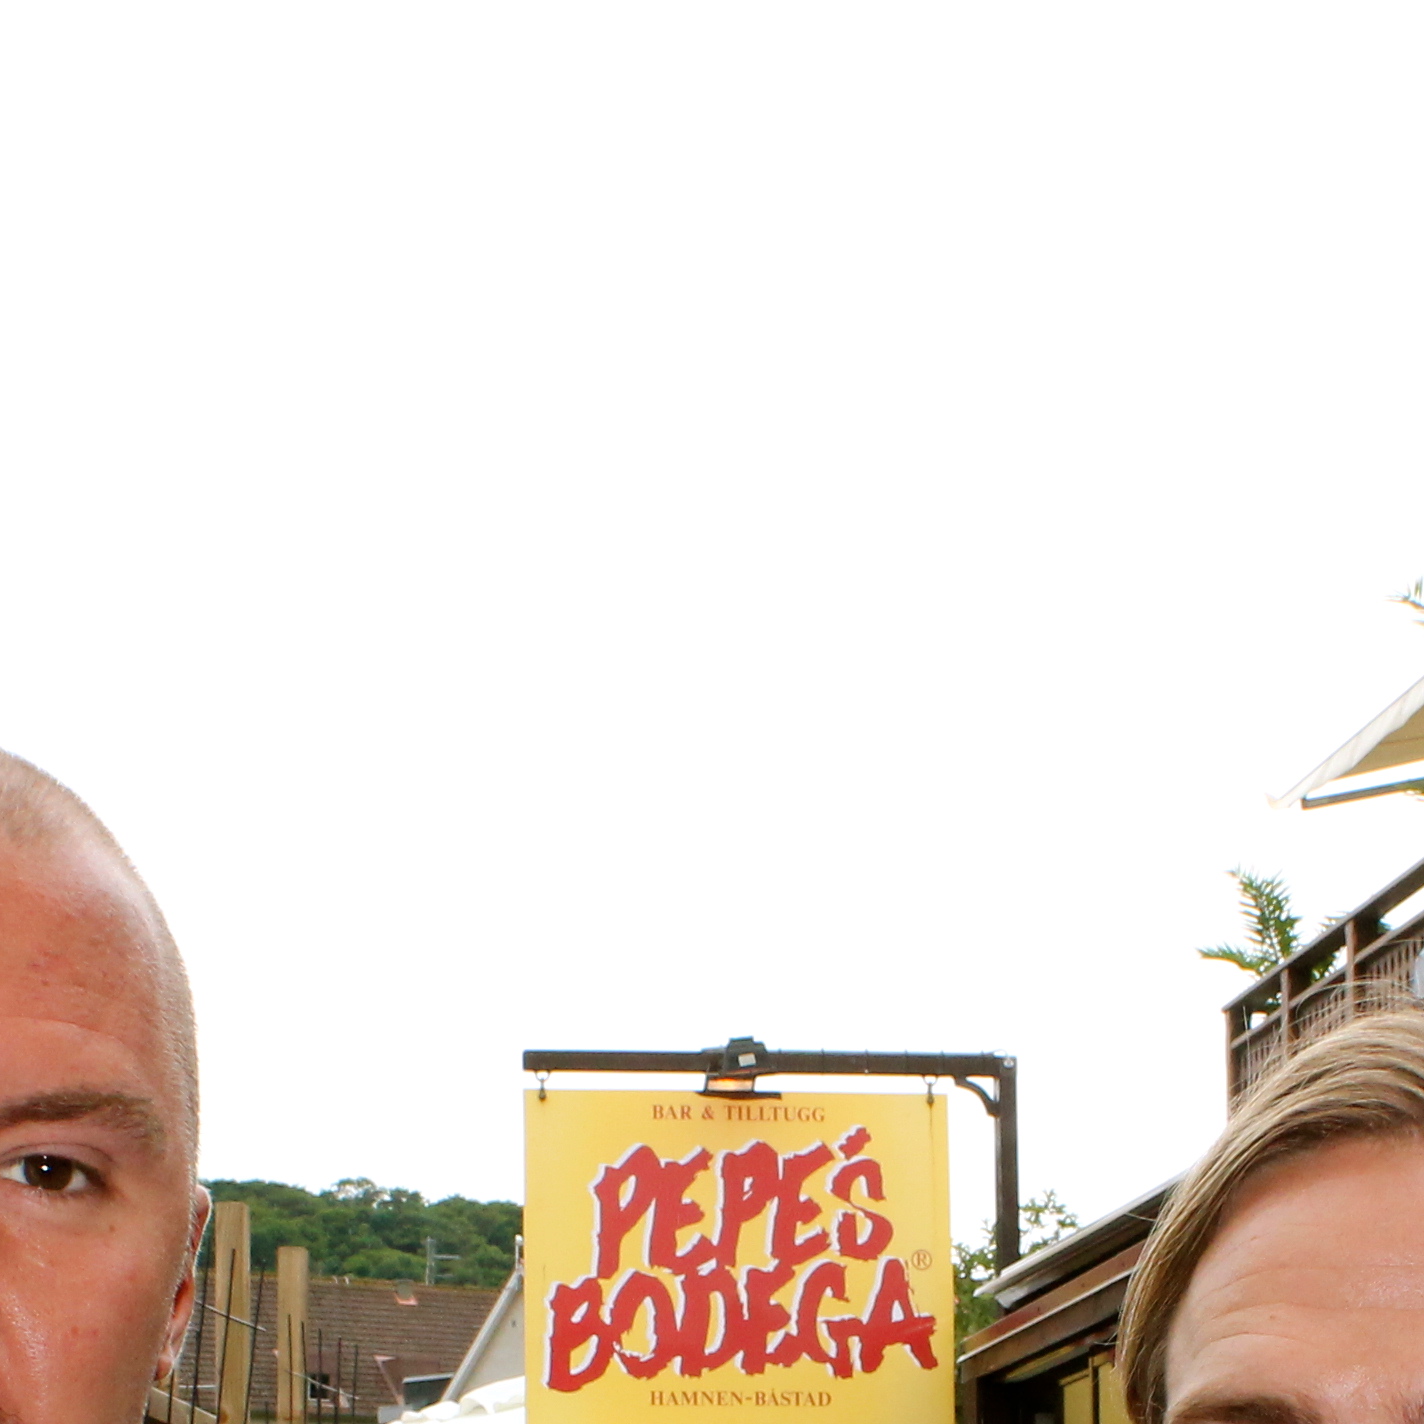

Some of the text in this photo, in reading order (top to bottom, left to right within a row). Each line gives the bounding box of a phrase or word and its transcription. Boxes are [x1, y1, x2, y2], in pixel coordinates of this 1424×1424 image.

[652, 1104, 825, 1122] BAR & TILLTUGG
[543, 1257, 938, 1391] BODEGA
